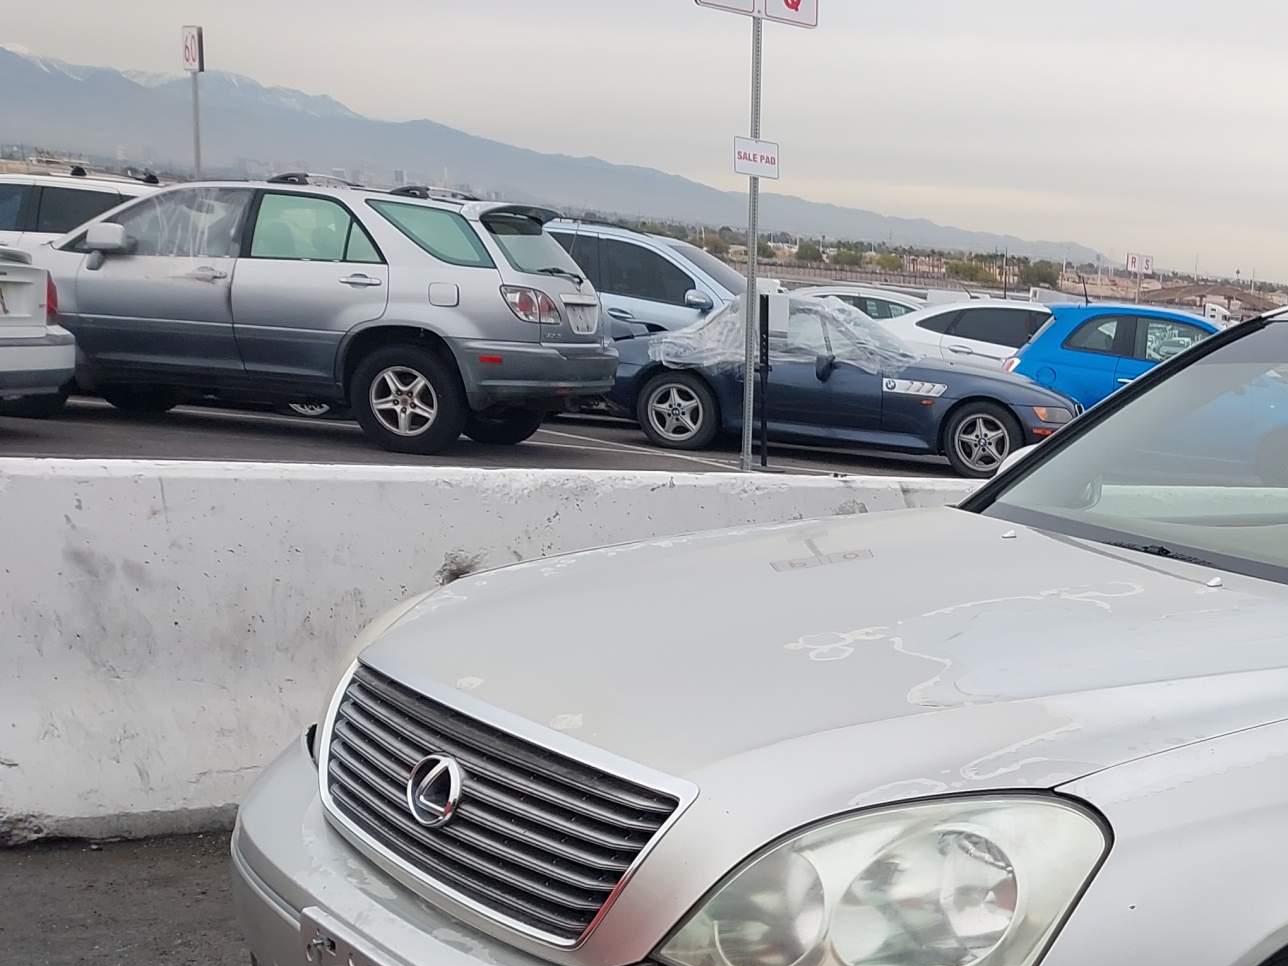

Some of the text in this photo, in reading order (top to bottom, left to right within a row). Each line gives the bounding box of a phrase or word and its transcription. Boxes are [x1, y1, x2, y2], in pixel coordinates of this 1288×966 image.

[737, 150, 776, 166] SALE PAD
[1131, 256, 1137, 269] R
[1144, 259, 1150, 271] S
